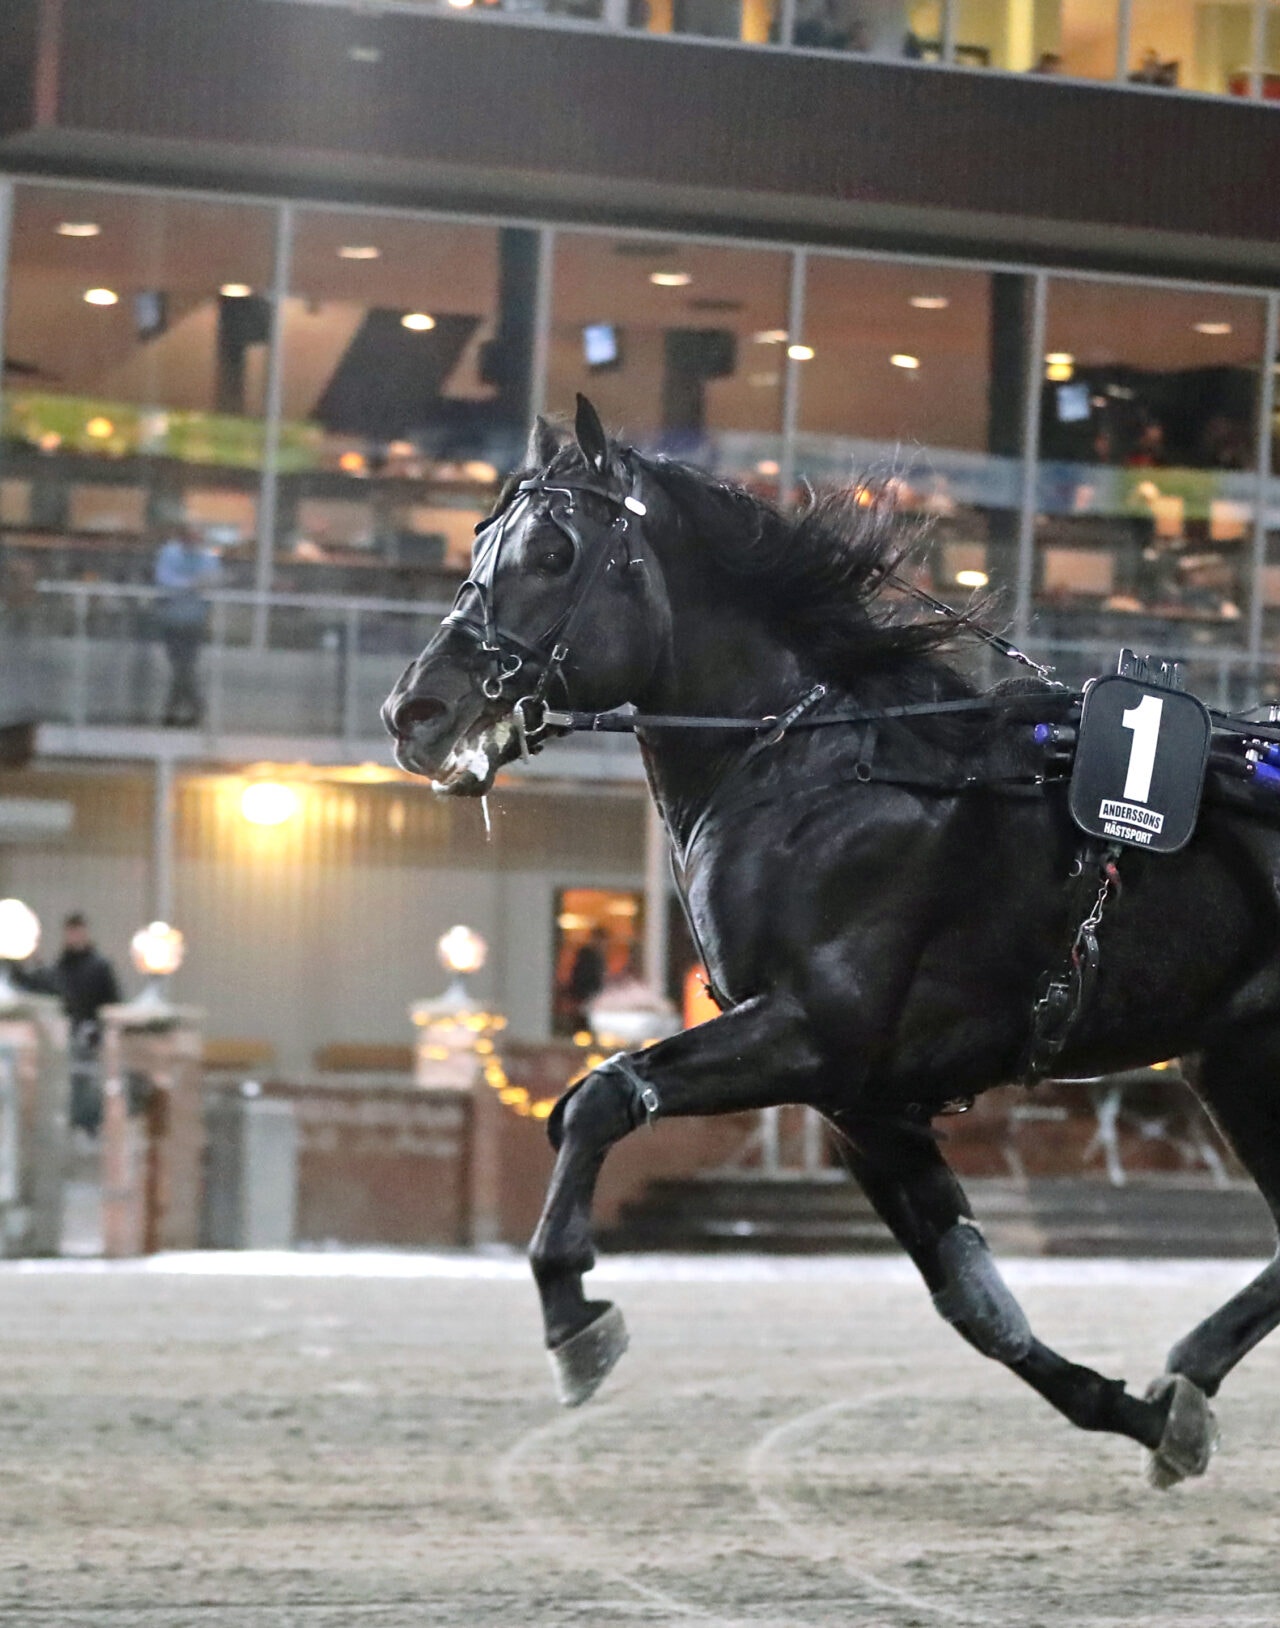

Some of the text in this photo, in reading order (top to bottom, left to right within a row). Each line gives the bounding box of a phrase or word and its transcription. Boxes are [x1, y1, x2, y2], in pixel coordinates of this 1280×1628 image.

[1122, 695, 1164, 804] 1
[1102, 803, 1162, 829] ANDERSSONS
[1103, 821, 1153, 845] HÄSTSPORT
